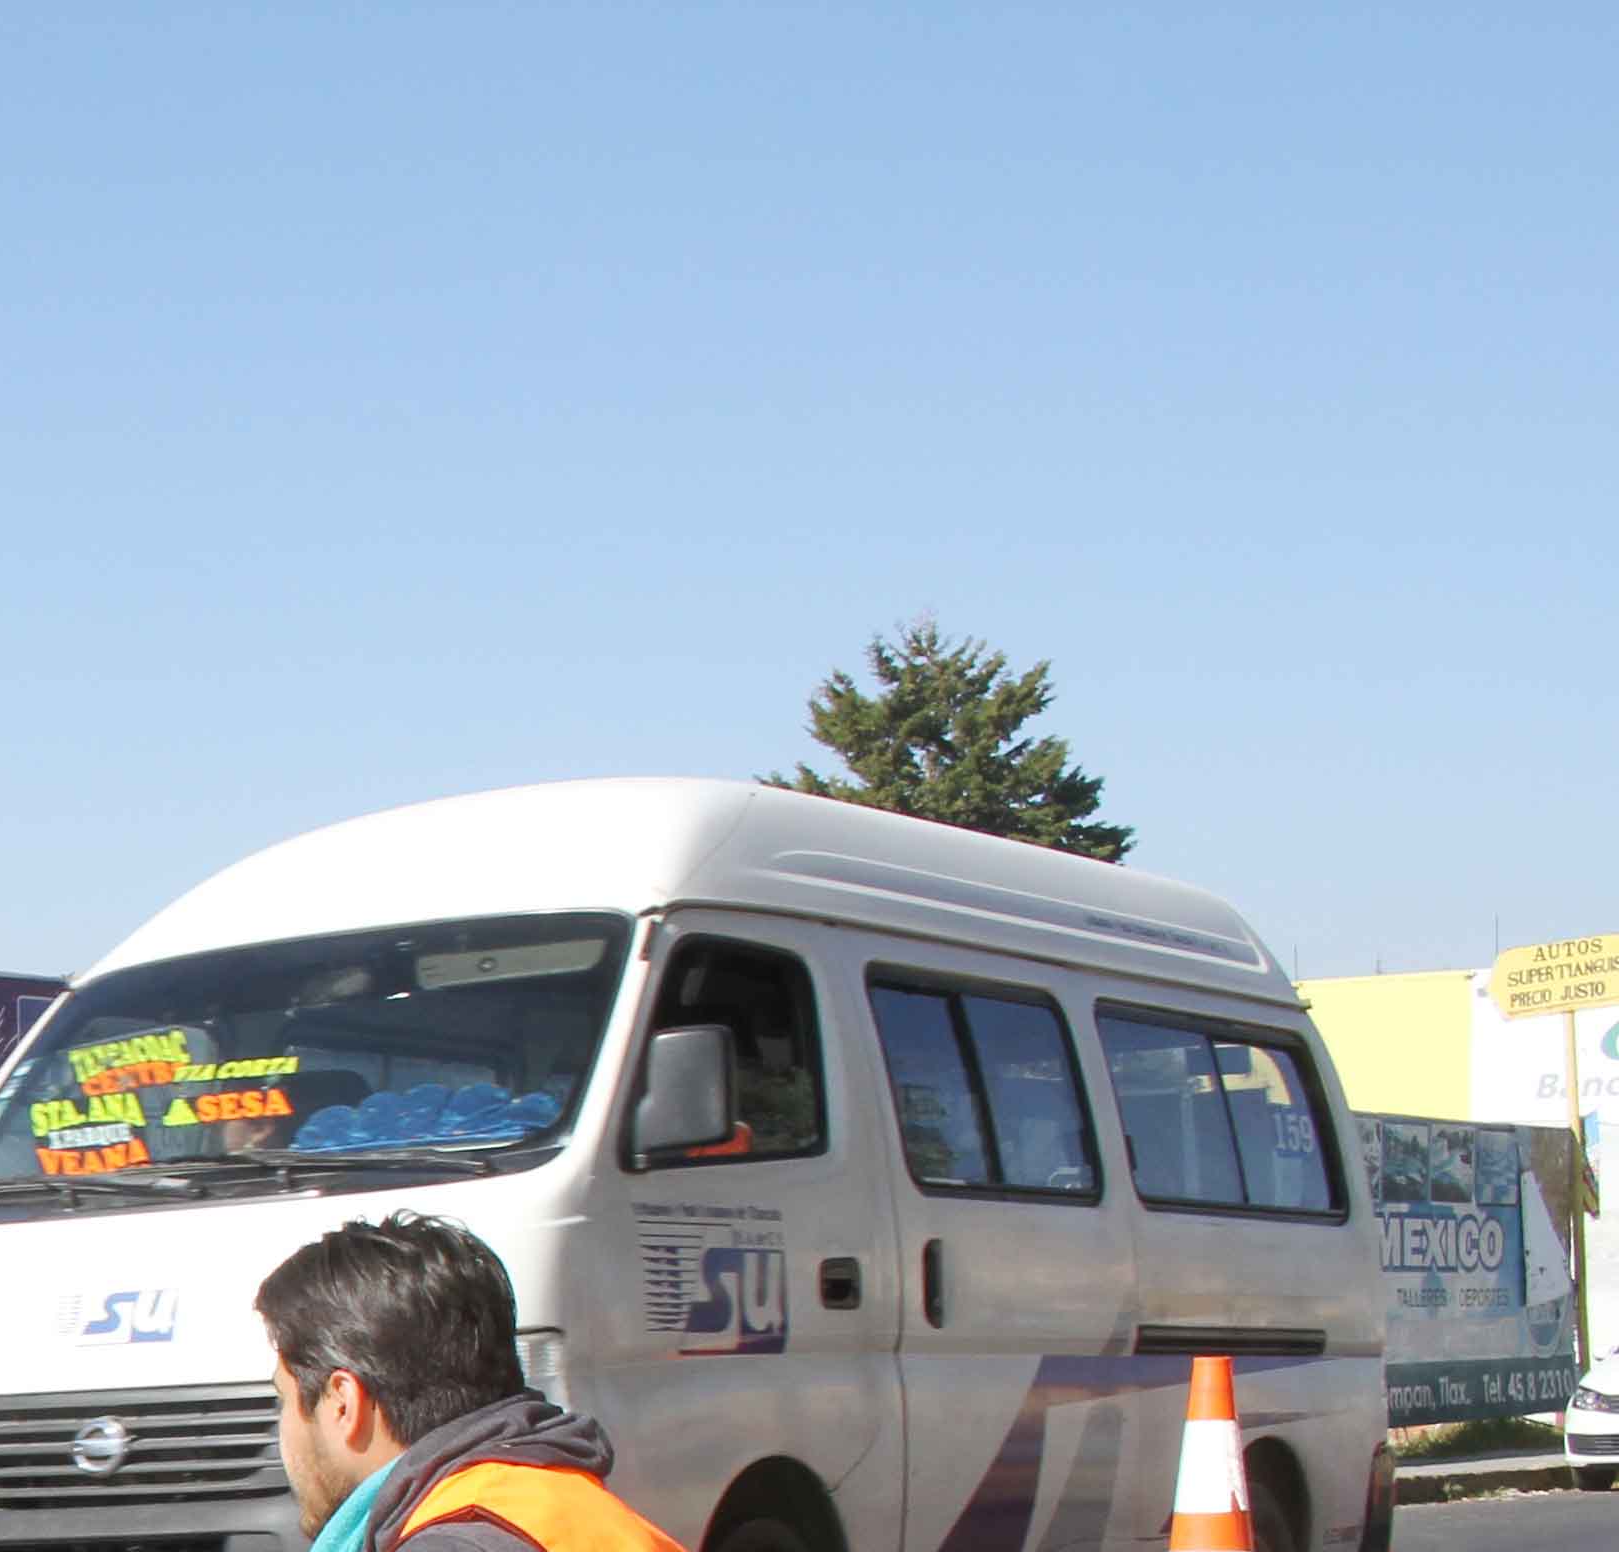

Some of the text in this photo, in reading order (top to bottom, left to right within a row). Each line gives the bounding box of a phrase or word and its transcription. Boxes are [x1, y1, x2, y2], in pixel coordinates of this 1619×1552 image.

[1533, 939, 1602, 962] AUTOS
[1510, 981, 1606, 1008] PRECIO JUSTO
[87, 1092, 147, 1127] ANA
[195, 1088, 295, 1124] SESA
[1389, 1384, 1436, 1416] mpan,
